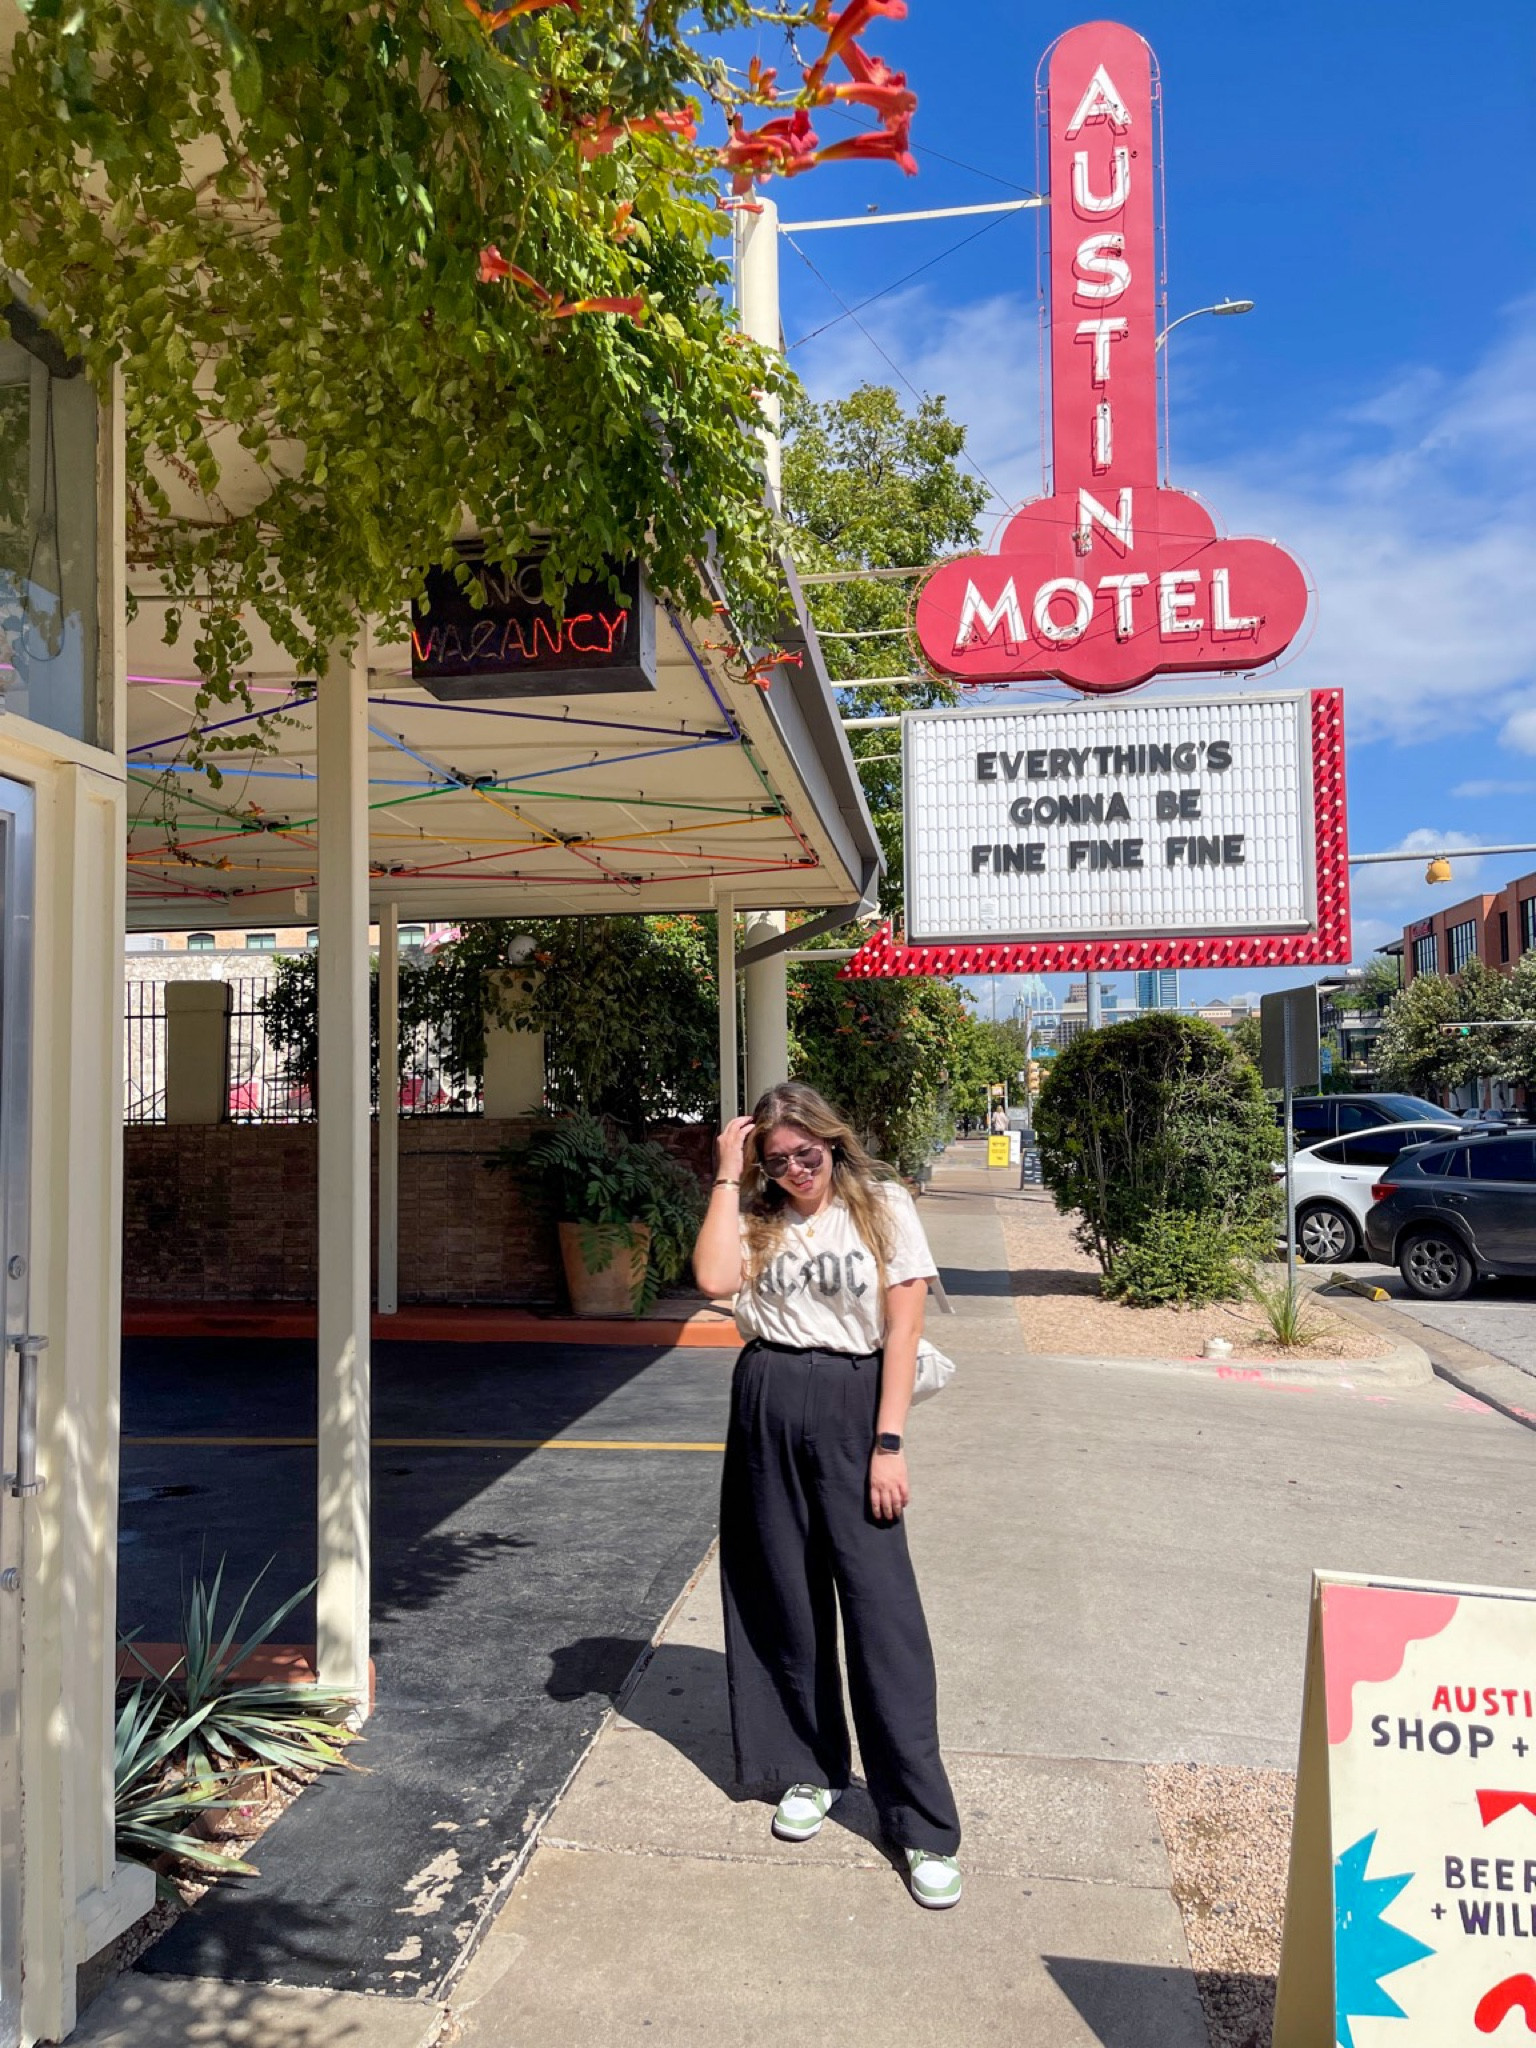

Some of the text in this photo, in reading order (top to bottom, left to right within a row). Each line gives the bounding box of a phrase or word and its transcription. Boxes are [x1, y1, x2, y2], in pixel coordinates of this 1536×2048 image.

[1067, 63, 1133, 556] AUSTIN
[953, 568, 1265, 652] MOTEL
[412, 608, 628, 663] VACANCY
[976, 741, 1233, 780] EVERYTHING'S
[1010, 788, 1201, 825] GONNA BE
[972, 834, 1245, 873] FINE FINE FINE
[1371, 1714, 1529, 1758] SHOP +
[1431, 1899, 1536, 1937] + WIL
